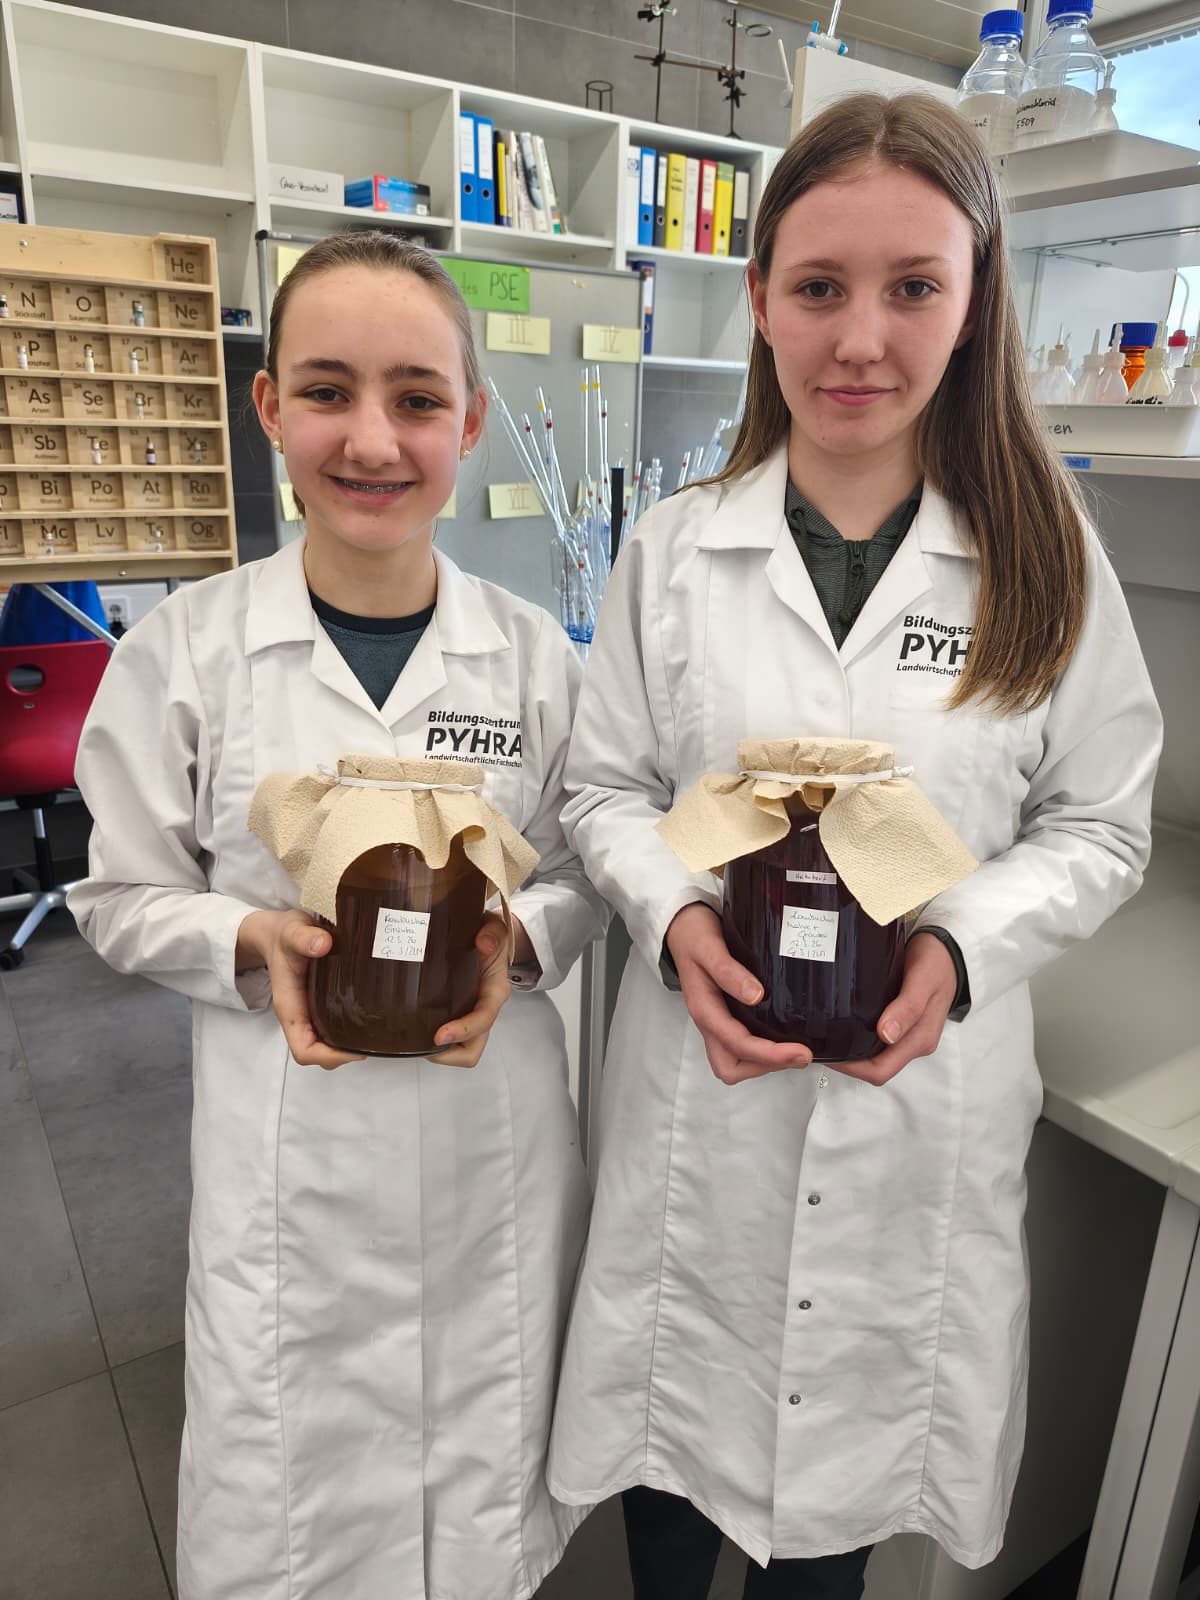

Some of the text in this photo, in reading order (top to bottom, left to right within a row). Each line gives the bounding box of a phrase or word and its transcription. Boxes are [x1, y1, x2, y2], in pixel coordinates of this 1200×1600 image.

[171, 257, 195, 274] He
[489, 271, 520, 301] PSE
[21, 291, 36, 308] N
[76, 296, 91, 312] O
[175, 304, 199, 320] Ne
[28, 340, 40, 356] P
[180, 349, 199, 365] Ar
[28, 388, 51, 404] As
[83, 390, 104, 406] Se
[184, 394, 203, 408] Kr
[34, 435, 56, 450] Sb
[87, 436, 109, 451] Te
[41, 480, 59, 495] Bi
[91, 480, 113, 495] Po
[143, 480, 161, 494] At
[190, 480, 211, 494] Rn
[41, 525, 69, 540] Mc
[96, 523, 115, 538] Lv
[192, 521, 215, 538] Og
[903, 615, 973, 637] Bildungsz
[899, 633, 973, 665] PYH
[896, 664, 964, 677] Landwirtschaft
[426, 728, 522, 758] PYHRA
